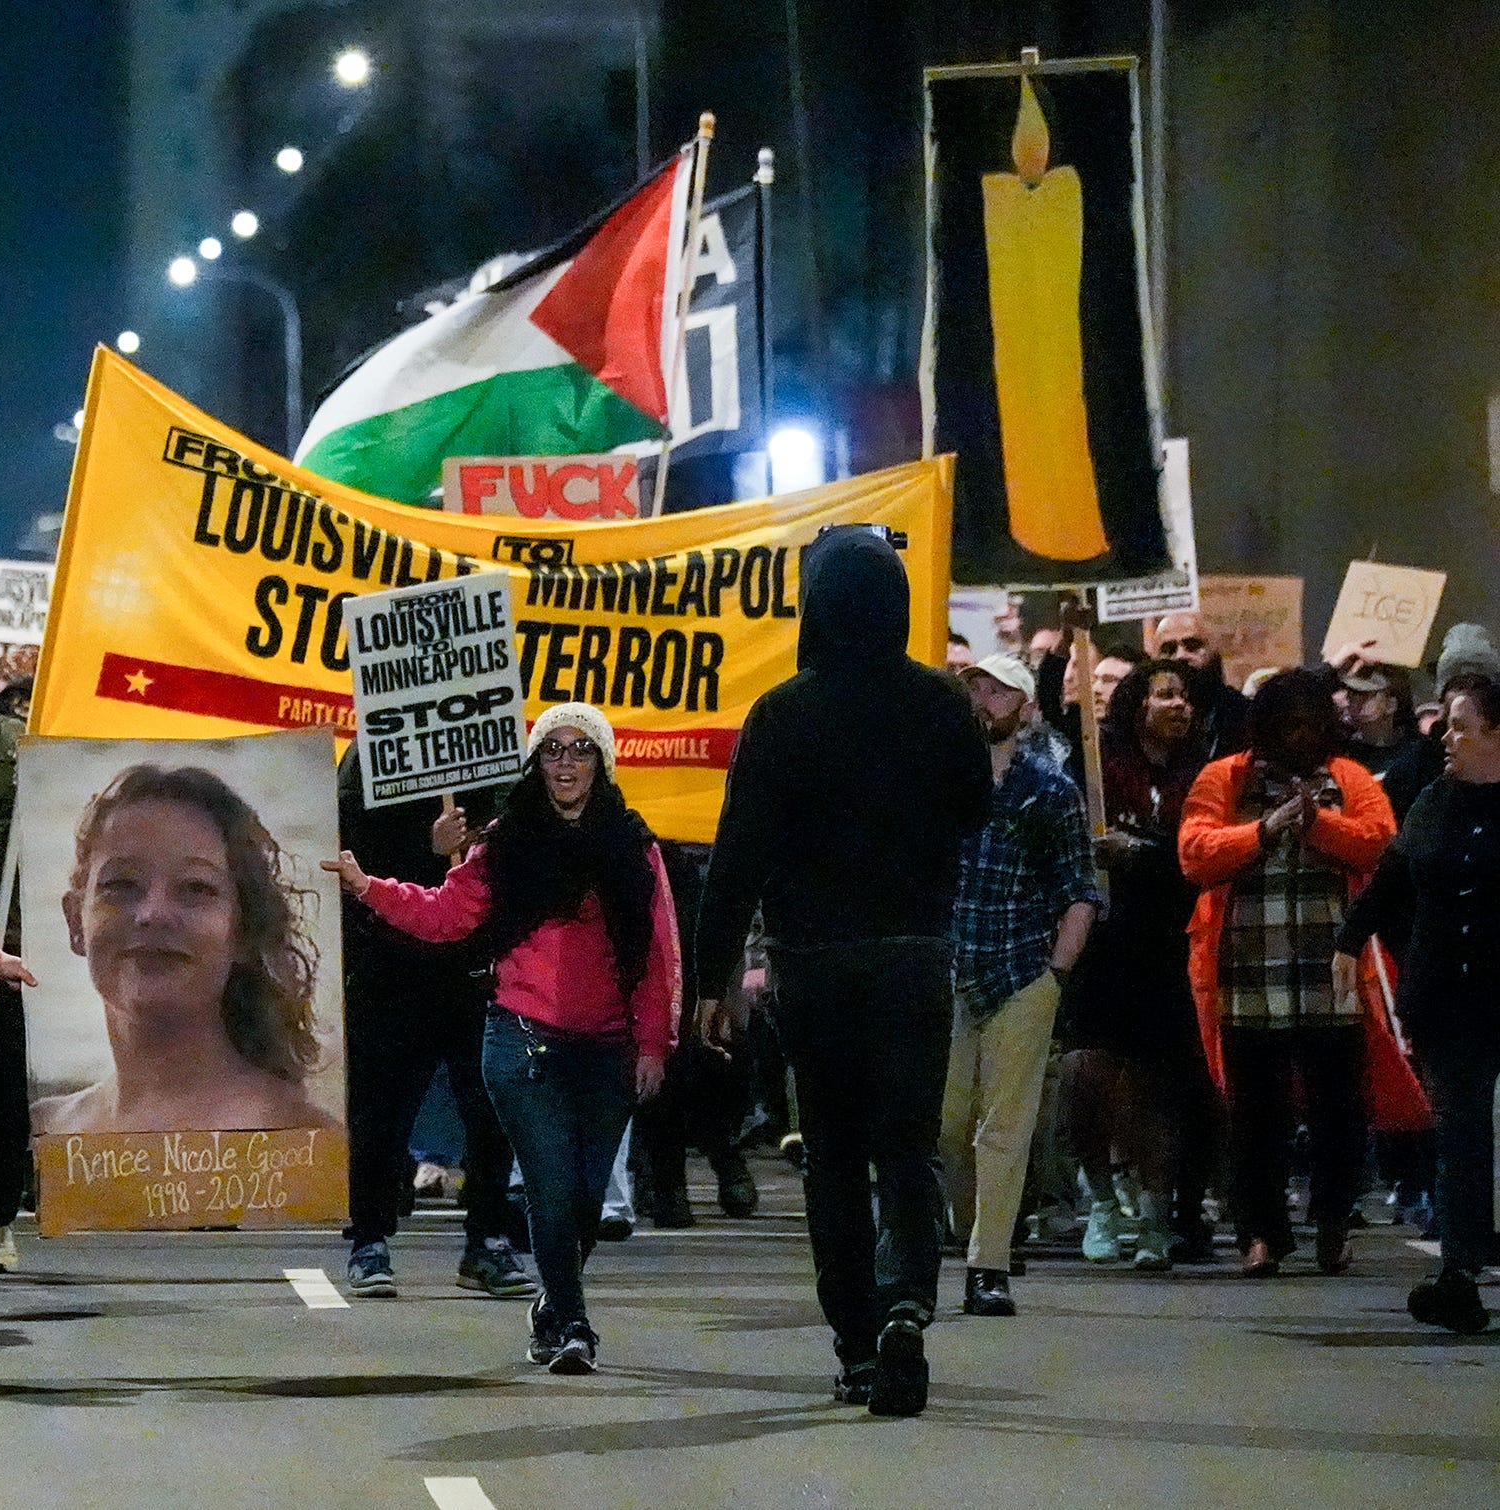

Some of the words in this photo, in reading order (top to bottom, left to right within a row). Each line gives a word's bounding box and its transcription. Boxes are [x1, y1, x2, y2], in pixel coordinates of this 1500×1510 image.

[173, 432, 292, 494] FRO
[458, 461, 639, 520] FUCK
[503, 540, 567, 567] TO
[526, 545, 804, 619] MINNEAPOL
[245, 575, 353, 672] STO
[515, 620, 725, 712] TERROR
[355, 590, 506, 655] LOUISVILLE
[360, 638, 509, 696] MINNEAPOLIS
[278, 695, 334, 727] PARTY
[336, 704, 357, 730] FO
[614, 738, 709, 759] LOUISVILLE
[365, 686, 515, 736] STOP
[368, 736, 413, 778] ICE
[415, 715, 519, 769] TERROR
[66, 1135, 150, 1187] Renée
[162, 1131, 238, 1177] Nicole
[247, 1128, 320, 1171] Good
